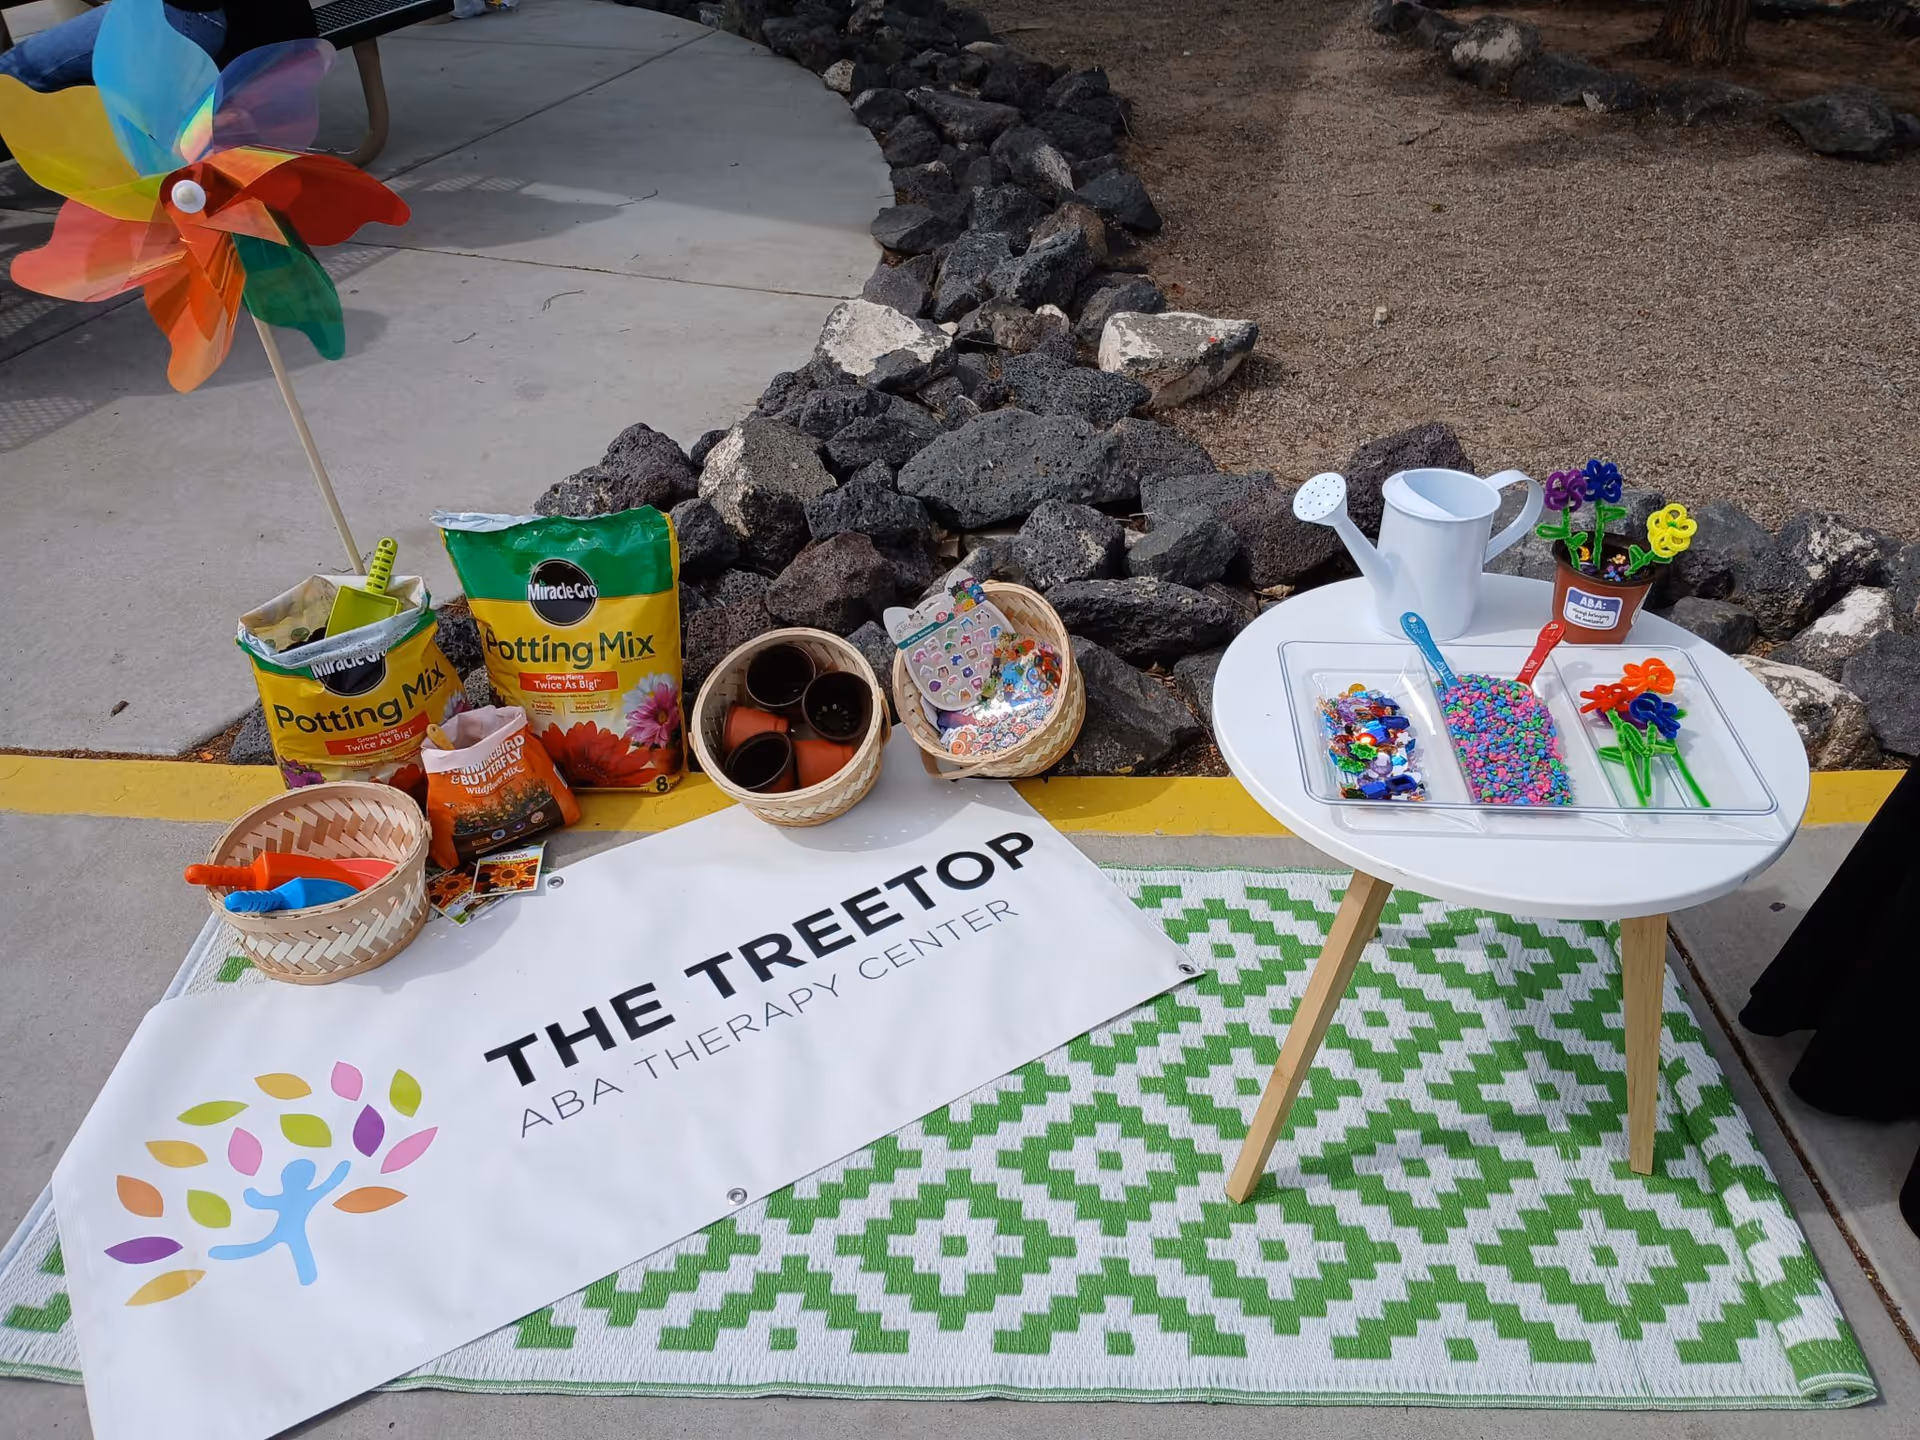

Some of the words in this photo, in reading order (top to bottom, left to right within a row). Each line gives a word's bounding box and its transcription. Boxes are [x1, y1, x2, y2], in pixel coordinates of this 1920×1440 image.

[527, 581, 598, 601] Miracle-Gro
[1580, 596, 1607, 610] ABA:
[485, 627, 594, 670] Potting
[599, 631, 657, 661] Mix
[310, 650, 387, 678] MiracleGro
[533, 680, 562, 690] Twice
[565, 680, 577, 689] As
[273, 698, 403, 733] Potting
[402, 661, 446, 710] Mix
[345, 742, 376, 752] Twice
[380, 738, 392, 746] As
[503, 766, 525, 780] Mix
[656, 776, 669, 792] 8
[484, 982, 676, 1087] THE
[684, 832, 1034, 999] TREETOP
[521, 1077, 624, 1139] ABA
[633, 973, 841, 1080] THERAPY
[858, 899, 1019, 981] CENTER
